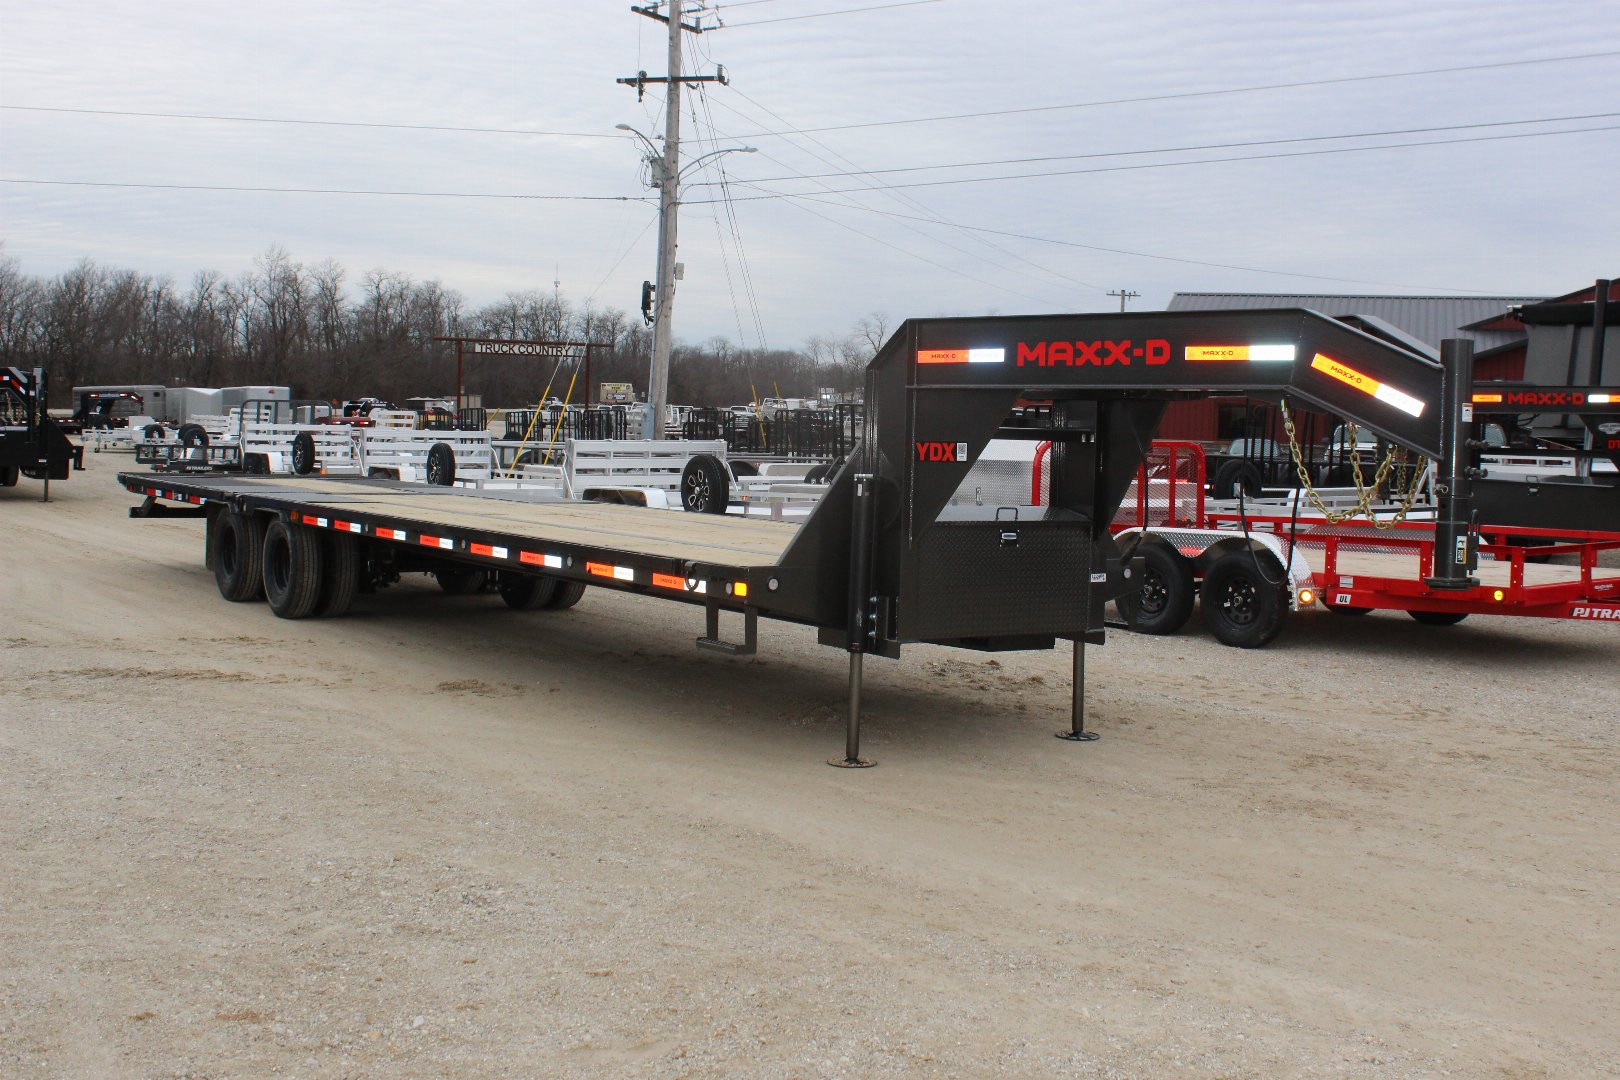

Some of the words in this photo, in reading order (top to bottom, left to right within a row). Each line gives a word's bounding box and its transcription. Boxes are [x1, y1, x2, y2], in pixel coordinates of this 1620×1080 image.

[479, 343, 516, 354] TRUCK
[518, 344, 571, 356] COUNTRY
[1016, 339, 1171, 367] MAXX-D
[1330, 365, 1362, 384] MAXX-D
[1507, 392, 1585, 405] MAXX-D
[915, 442, 956, 462] YDX
[1572, 607, 1591, 618] PJ
